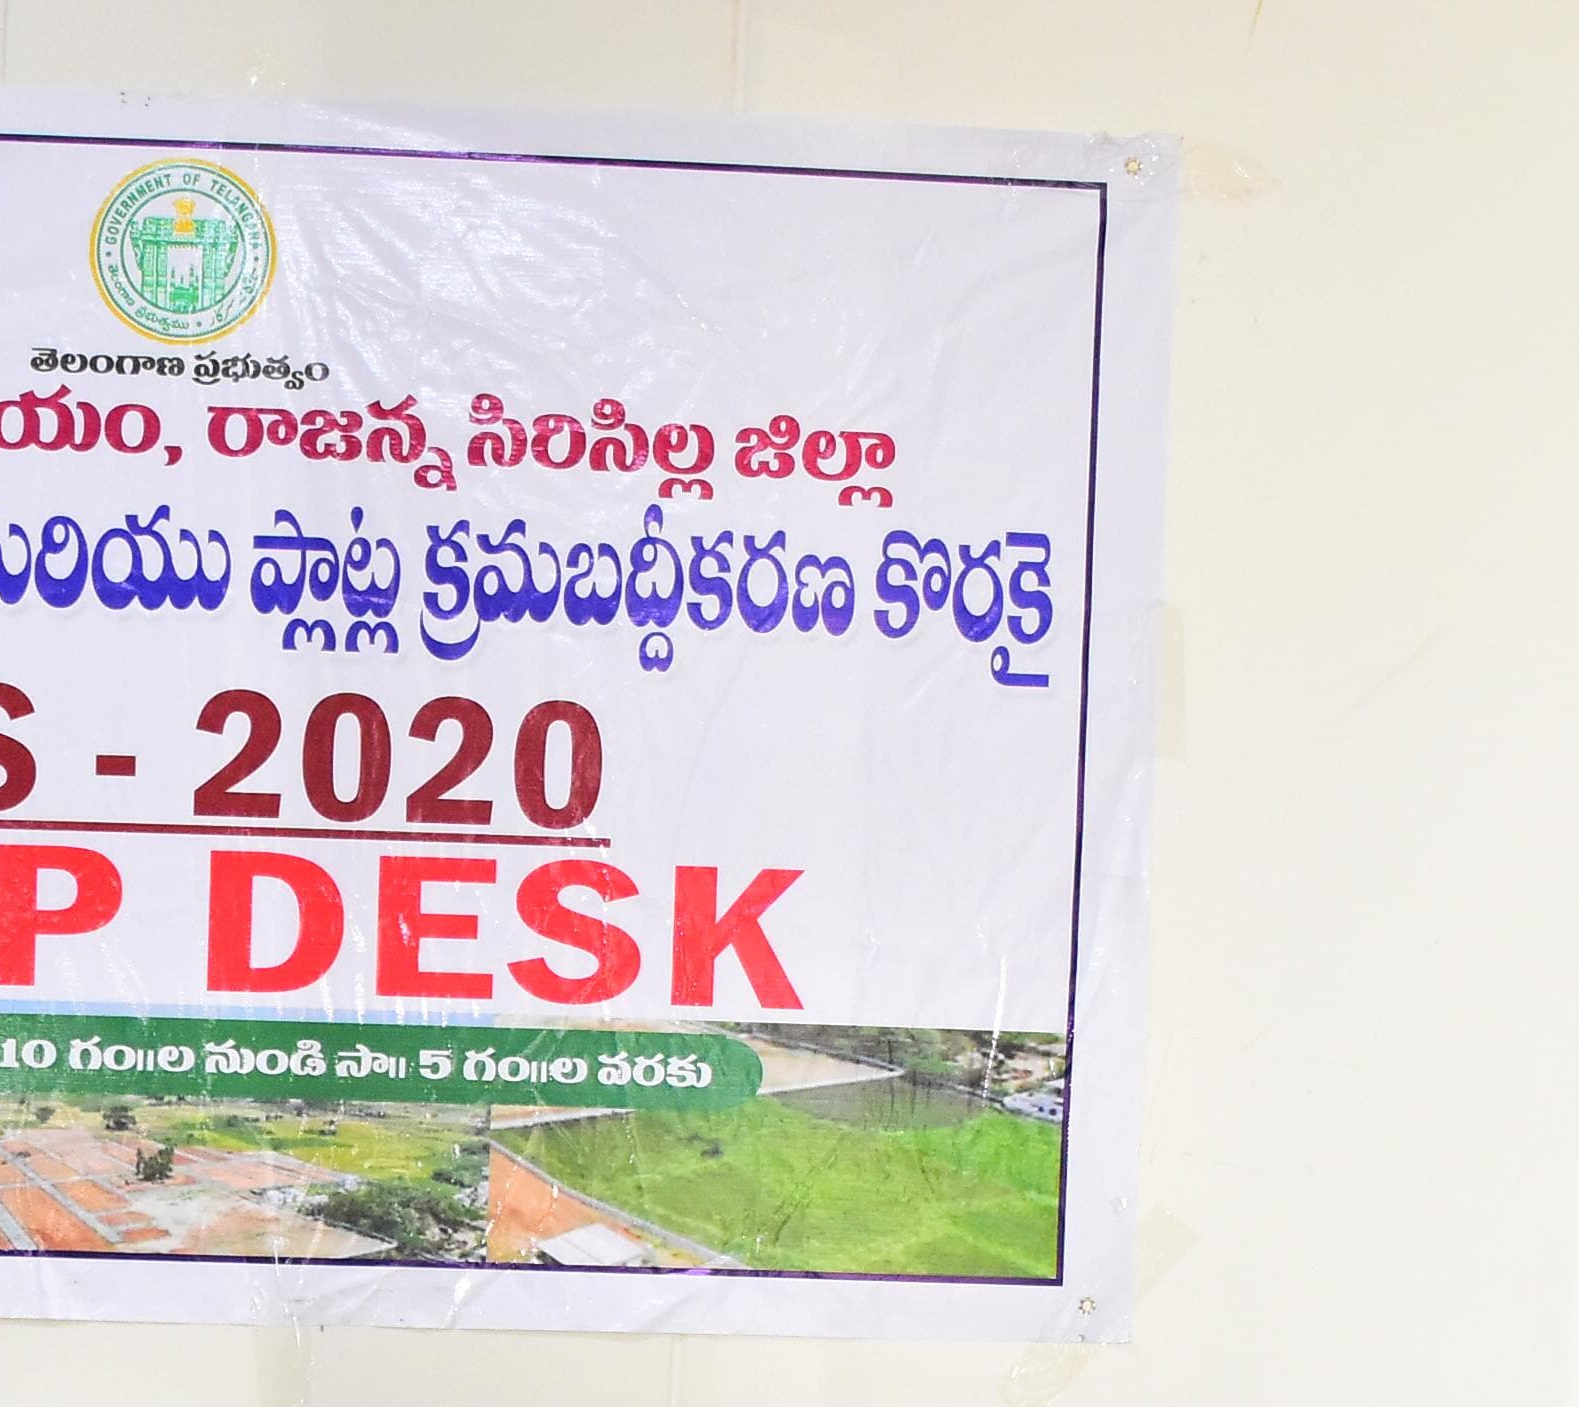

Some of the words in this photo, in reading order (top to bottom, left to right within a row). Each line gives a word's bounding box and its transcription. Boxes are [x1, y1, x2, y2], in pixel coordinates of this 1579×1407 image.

[105, 173, 172, 246] GOVERNMENT
[182, 173, 201, 186] OF
[30, 347, 185, 377] తెలంగాణ
[192, 351, 330, 391] ప్రభుత్వం
[207, 394, 456, 491] రాజన్న
[466, 393, 716, 501] సిరిసిల్ల
[733, 414, 898, 509] జిల్లా
[250, 505, 403, 654] ప్లాట్ల
[875, 529, 1055, 688] కొరకై
[95, 754, 137, 777] -
[193, 688, 604, 833] 2020
[207, 848, 807, 1011] DESK
[203, 1039, 327, 1076] నుండి
[419, 1048, 453, 1080] 5
[597, 1050, 714, 1088] వరకు
